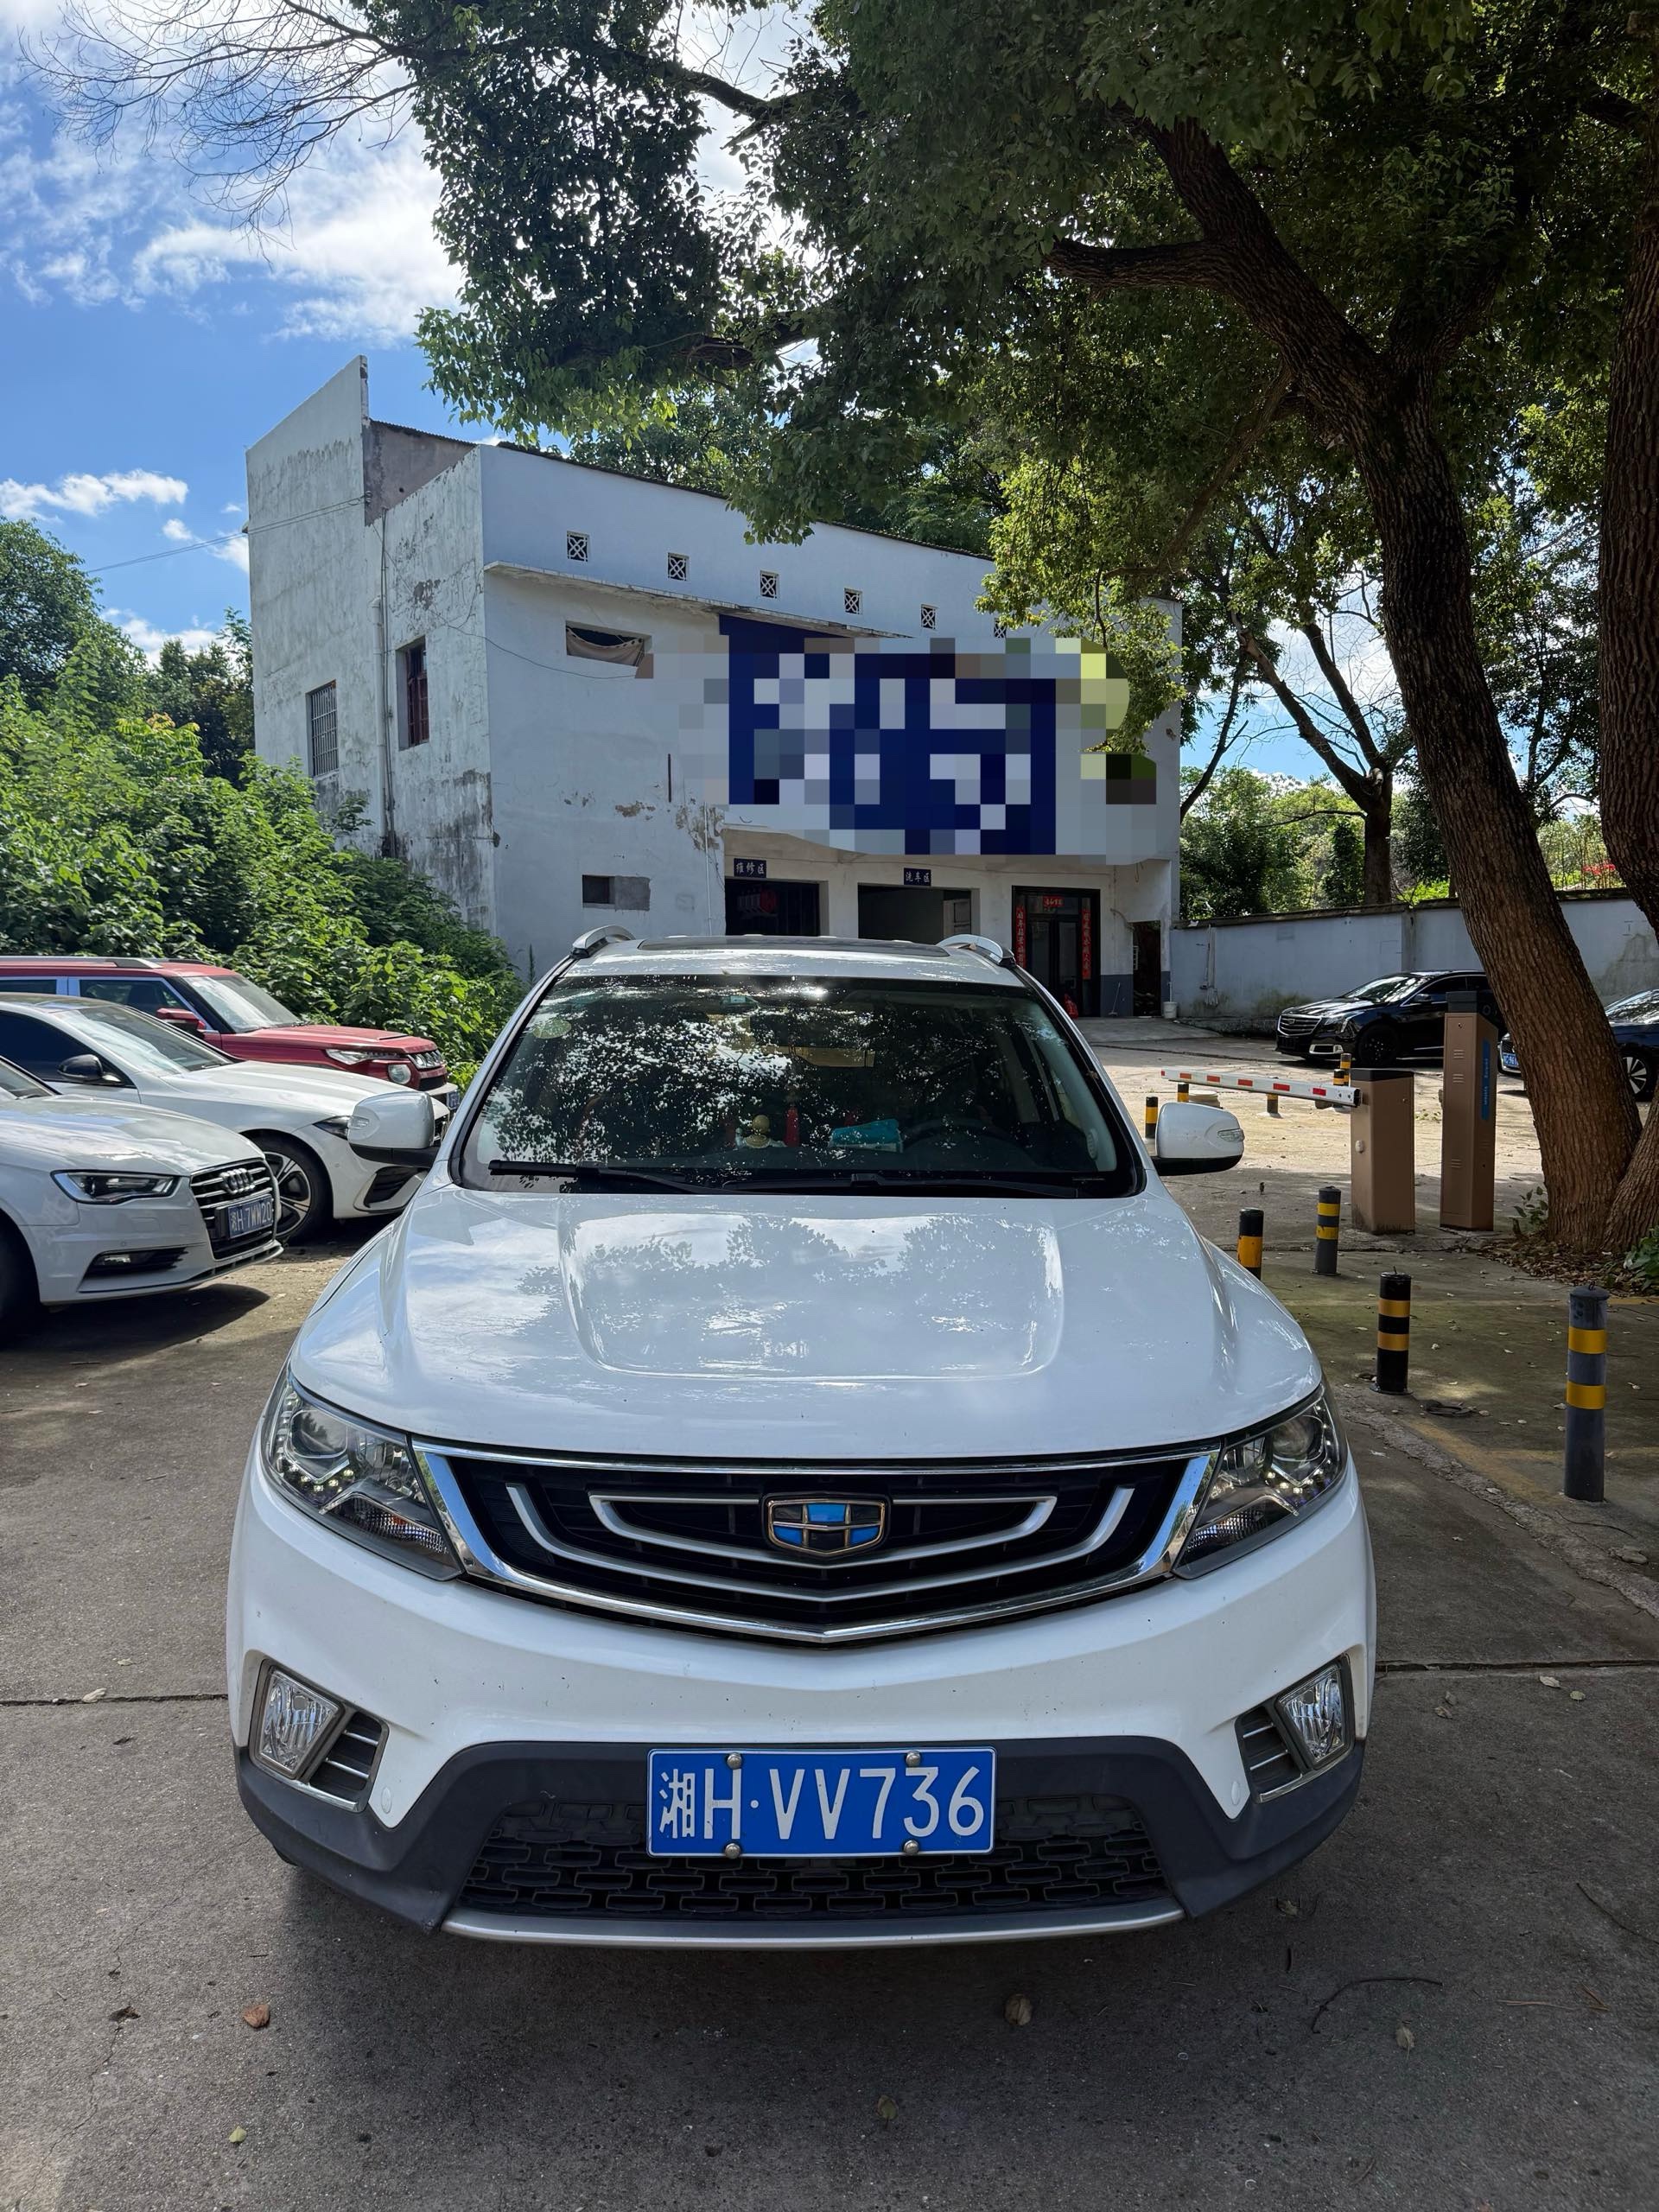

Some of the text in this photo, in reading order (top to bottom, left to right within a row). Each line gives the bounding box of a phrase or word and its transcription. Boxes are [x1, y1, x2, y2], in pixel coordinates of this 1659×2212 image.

[736, 861, 765, 875] 维修区
[905, 870, 931, 883] 洗车区
